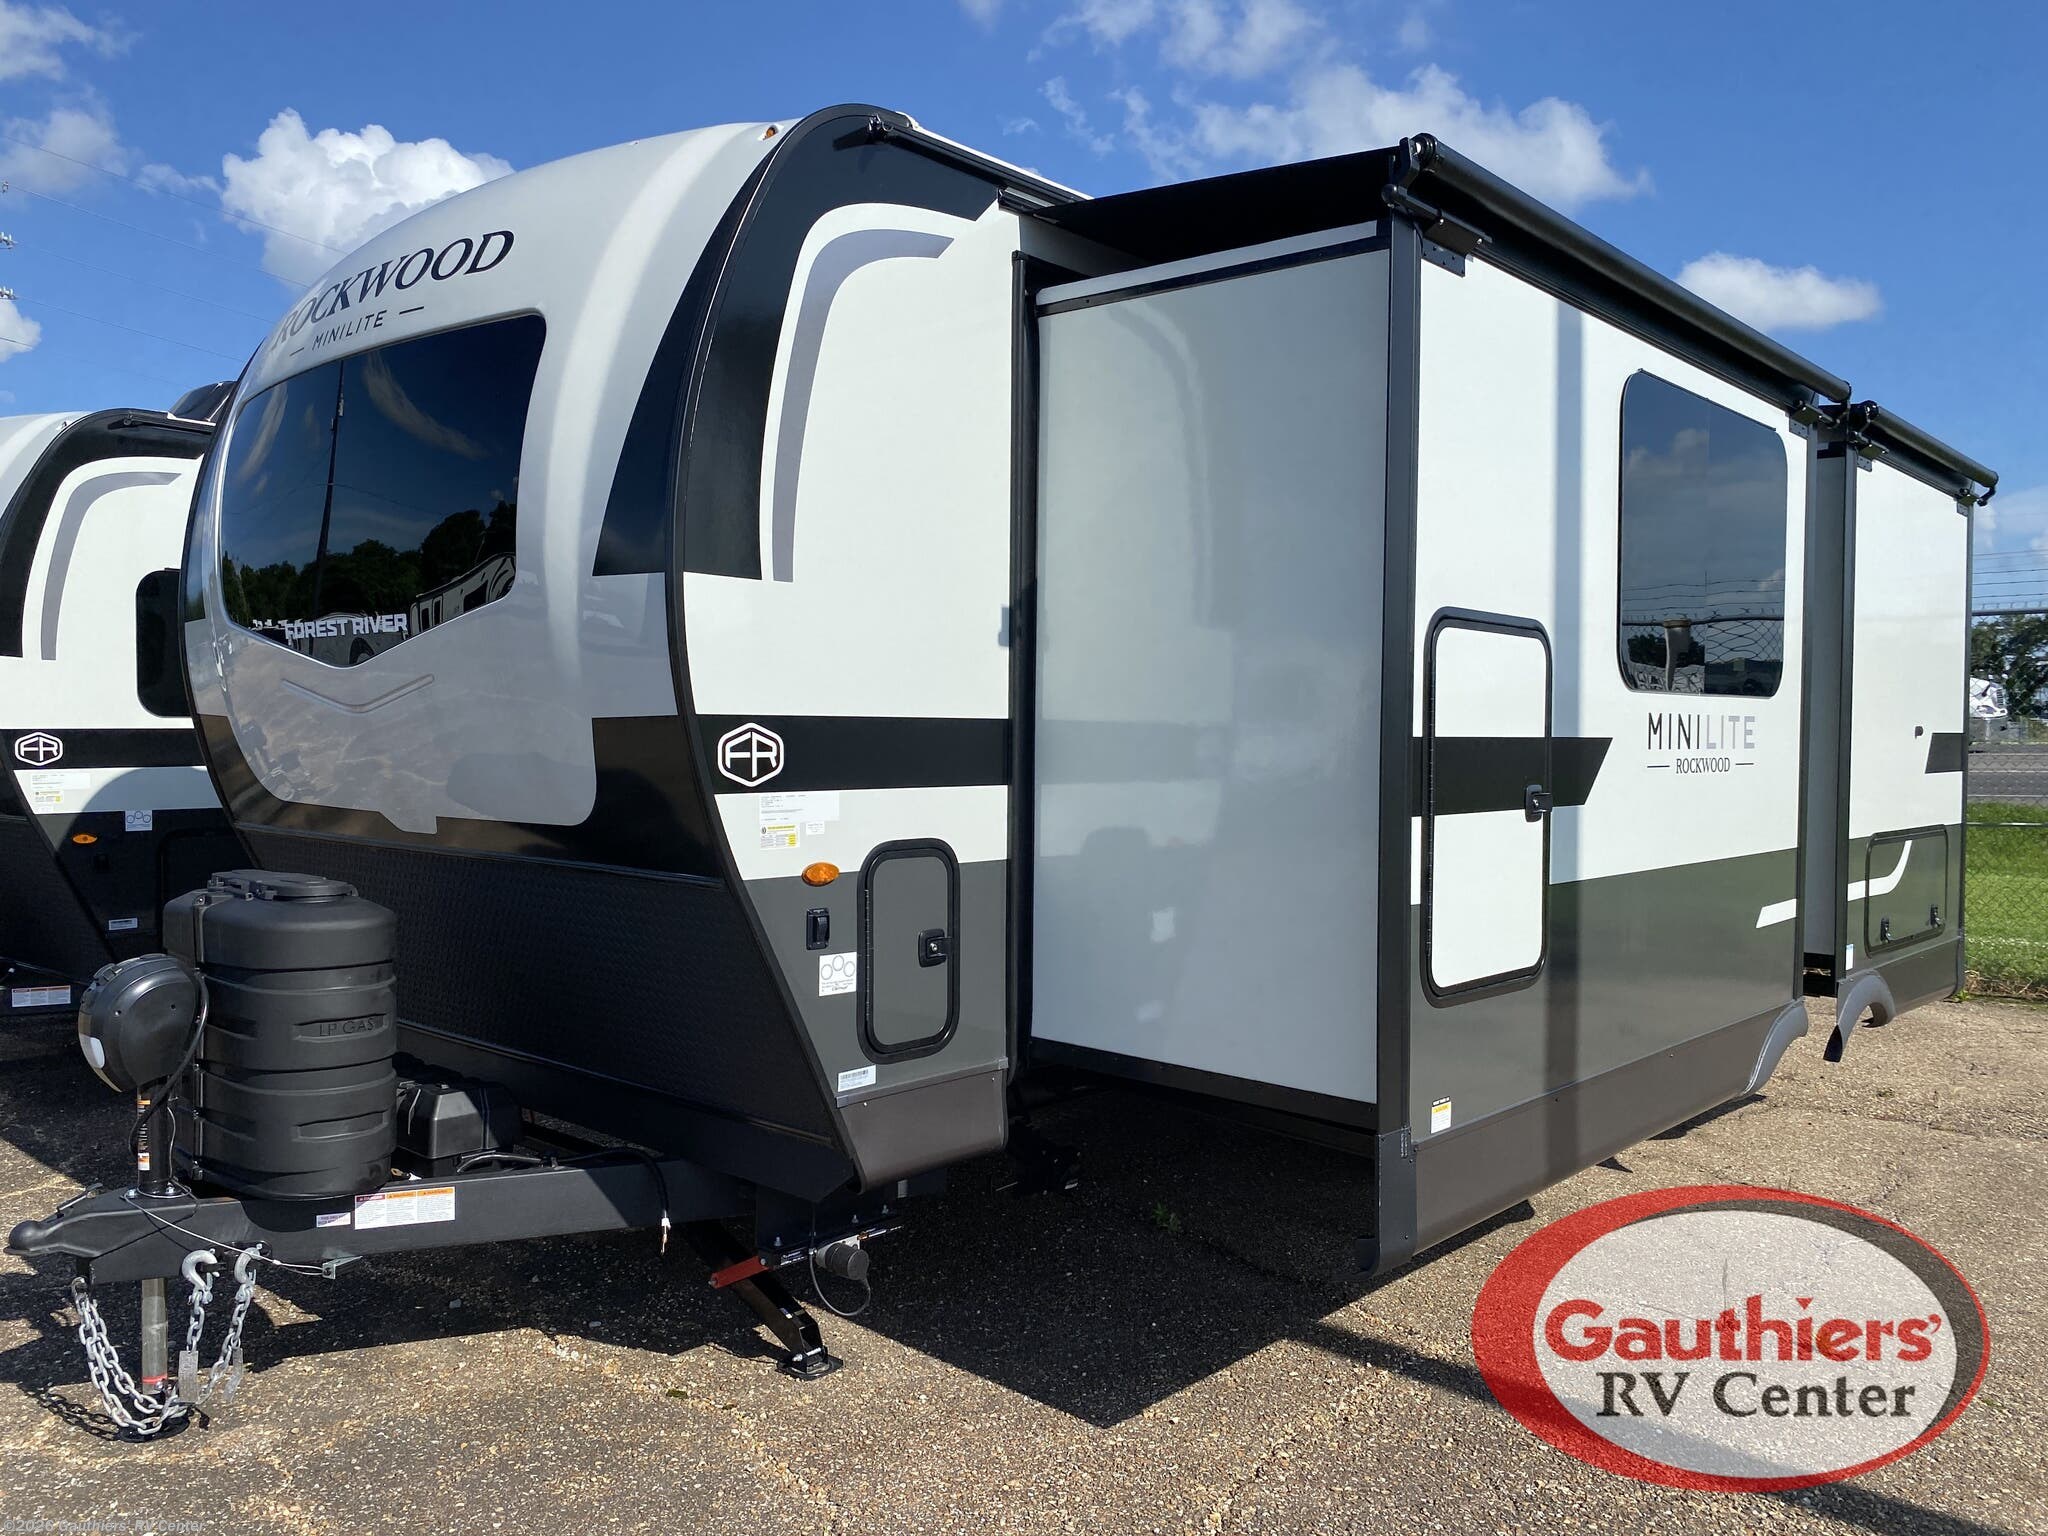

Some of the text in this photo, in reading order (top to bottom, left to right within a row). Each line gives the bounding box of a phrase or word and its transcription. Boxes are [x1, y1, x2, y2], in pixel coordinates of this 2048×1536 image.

[269, 230, 515, 351] ROCKWOOD
[311, 309, 388, 351] MINILITE
[285, 613, 408, 640] FOREST RIVER
[1676, 757, 1731, 774] ROCKWOOD
[319, 1018, 375, 1037] LP GAS
